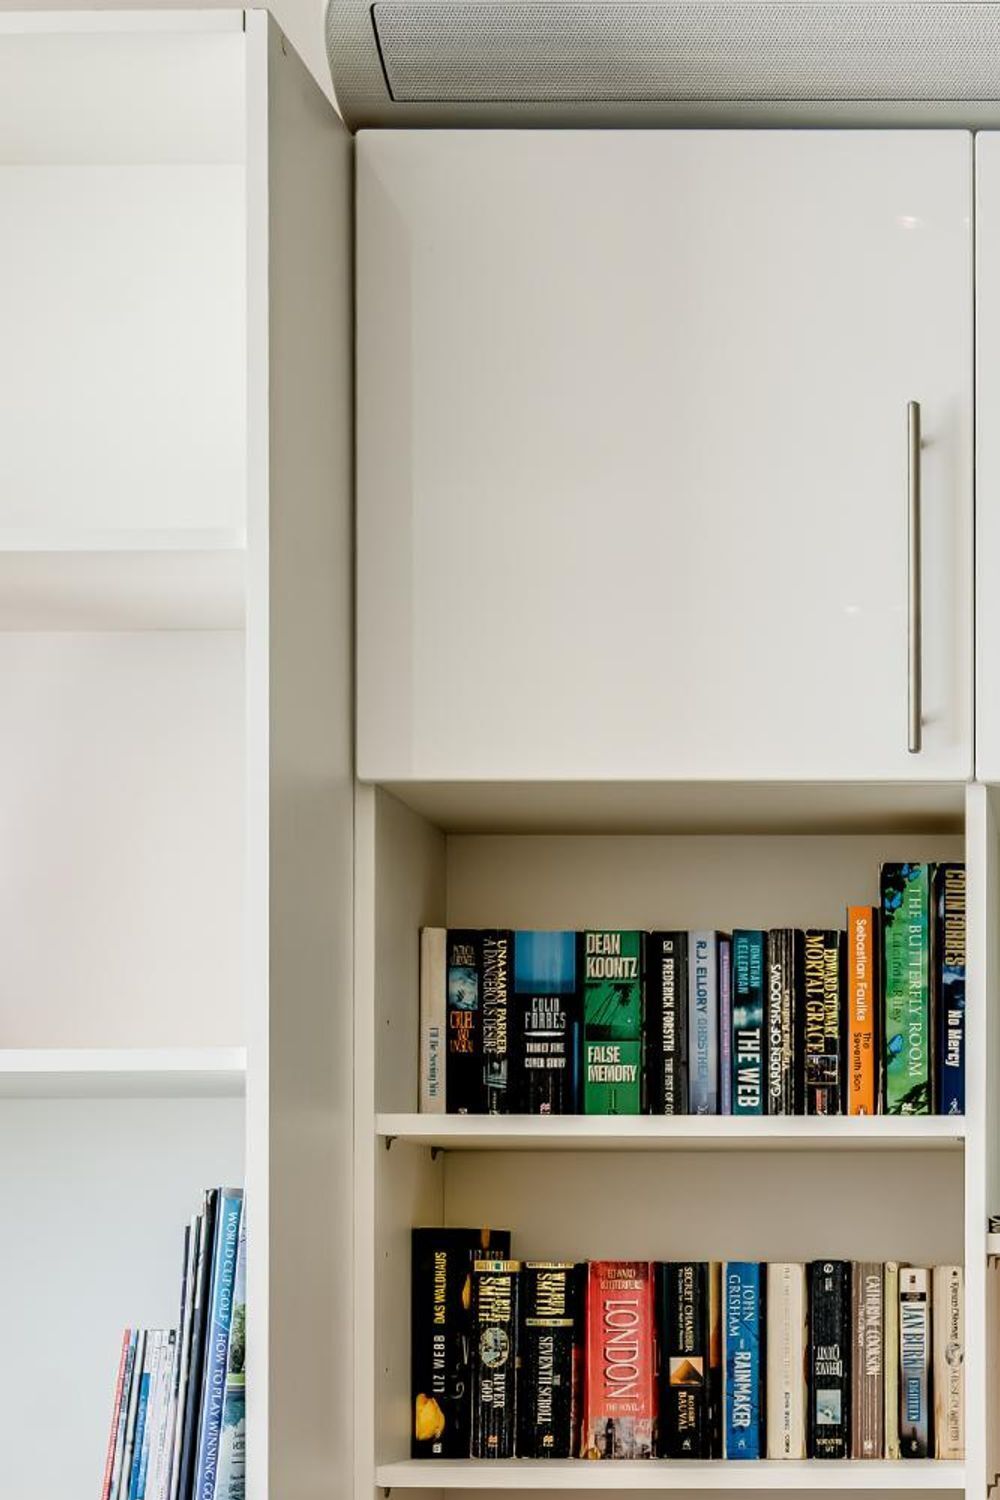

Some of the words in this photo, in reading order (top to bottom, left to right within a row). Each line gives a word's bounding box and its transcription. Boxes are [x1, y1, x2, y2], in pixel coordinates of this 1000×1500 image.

[908, 888, 921, 919] THE
[945, 869, 965, 909] COLIN
[483, 937, 496, 946] A
[587, 933, 620, 954] DEAN
[696, 941, 707, 963] R.J.
[856, 918, 867, 978] Sebastian
[945, 913, 965, 966] FORBES
[483, 949, 497, 1016] DANGEROUS
[497, 939, 507, 1005] UNA-MARY
[587, 957, 637, 978] KOONTZ
[663, 958, 674, 1008] FREDERICK
[738, 937, 749, 993] KELLERMAN
[750, 944, 760, 988] JONATHAN
[806, 936, 825, 998] MORTAL
[824, 948, 838, 992] EDWARD
[908, 924, 921, 1016] BUTTERFLY
[532, 998, 559, 1012] COLIN
[696, 967, 707, 1014] ELLORY
[771, 964, 781, 1025] SHADOWS
[856, 981, 867, 1021] Faulks
[497, 1008, 507, 1054] PARKER
[525, 1012, 566, 1029] FORBES
[663, 1011, 675, 1051] FORSYTH
[806, 1001, 825, 1053] GRACE
[824, 993, 838, 1039] STEWART
[948, 1009, 963, 1025] No
[483, 1018, 497, 1054] DESIRE
[588, 1046, 621, 1063] FALSE
[738, 1029, 760, 1063] THE
[853, 1032, 862, 1071] Seventh
[862, 1032, 871, 1049] The
[908, 1022, 921, 1076] ROOM
[946, 1029, 963, 1067] Mercy
[588, 1065, 637, 1082] MEMORY
[665, 1057, 673, 1073] THE
[665, 1075, 673, 1090] FIST
[771, 1047, 781, 1097] GARDEN
[853, 1074, 862, 1091] Son
[665, 1092, 673, 1102] OF
[738, 1068, 760, 1107] WEB
[225, 1211, 239, 1258] WORLD
[222, 1259, 233, 1286] CUP
[434, 1252, 447, 1303] WALDHAUS
[684, 1266, 693, 1301] SECRET
[218, 1287, 231, 1322] GOLF
[479, 1276, 494, 1323] SMITH
[493, 1277, 511, 1322] WILBUR
[536, 1272, 552, 1315] SMITH
[551, 1272, 566, 1315] WILBUR
[729, 1275, 741, 1337] GRISHAM
[743, 1284, 755, 1322] JOHN
[866, 1275, 881, 1327] CATHERINE
[434, 1304, 446, 1324] DAS
[684, 1304, 693, 1353] CHAMBER
[902, 1304, 925, 1330] JAN
[215, 1333, 227, 1362] HOW
[433, 1335, 445, 1369] WEBB
[538, 1336, 552, 1384] SEVENTH
[604, 1299, 639, 1399] LONDON
[866, 1329, 881, 1376] COOKSON
[213, 1367, 224, 1385] TO
[433, 1373, 445, 1392] LIZ
[481, 1380, 493, 1402] GOD
[493, 1373, 505, 1408] RIVER
[732, 1351, 751, 1428] RAINMAKER
[210, 1385, 221, 1415] PLAY
[537, 1386, 552, 1424] SCROLL
[678, 1391, 687, 1431] BAUVAL
[688, 1394, 696, 1428] ROBERT
[205, 1417, 218, 1480] WINNING
